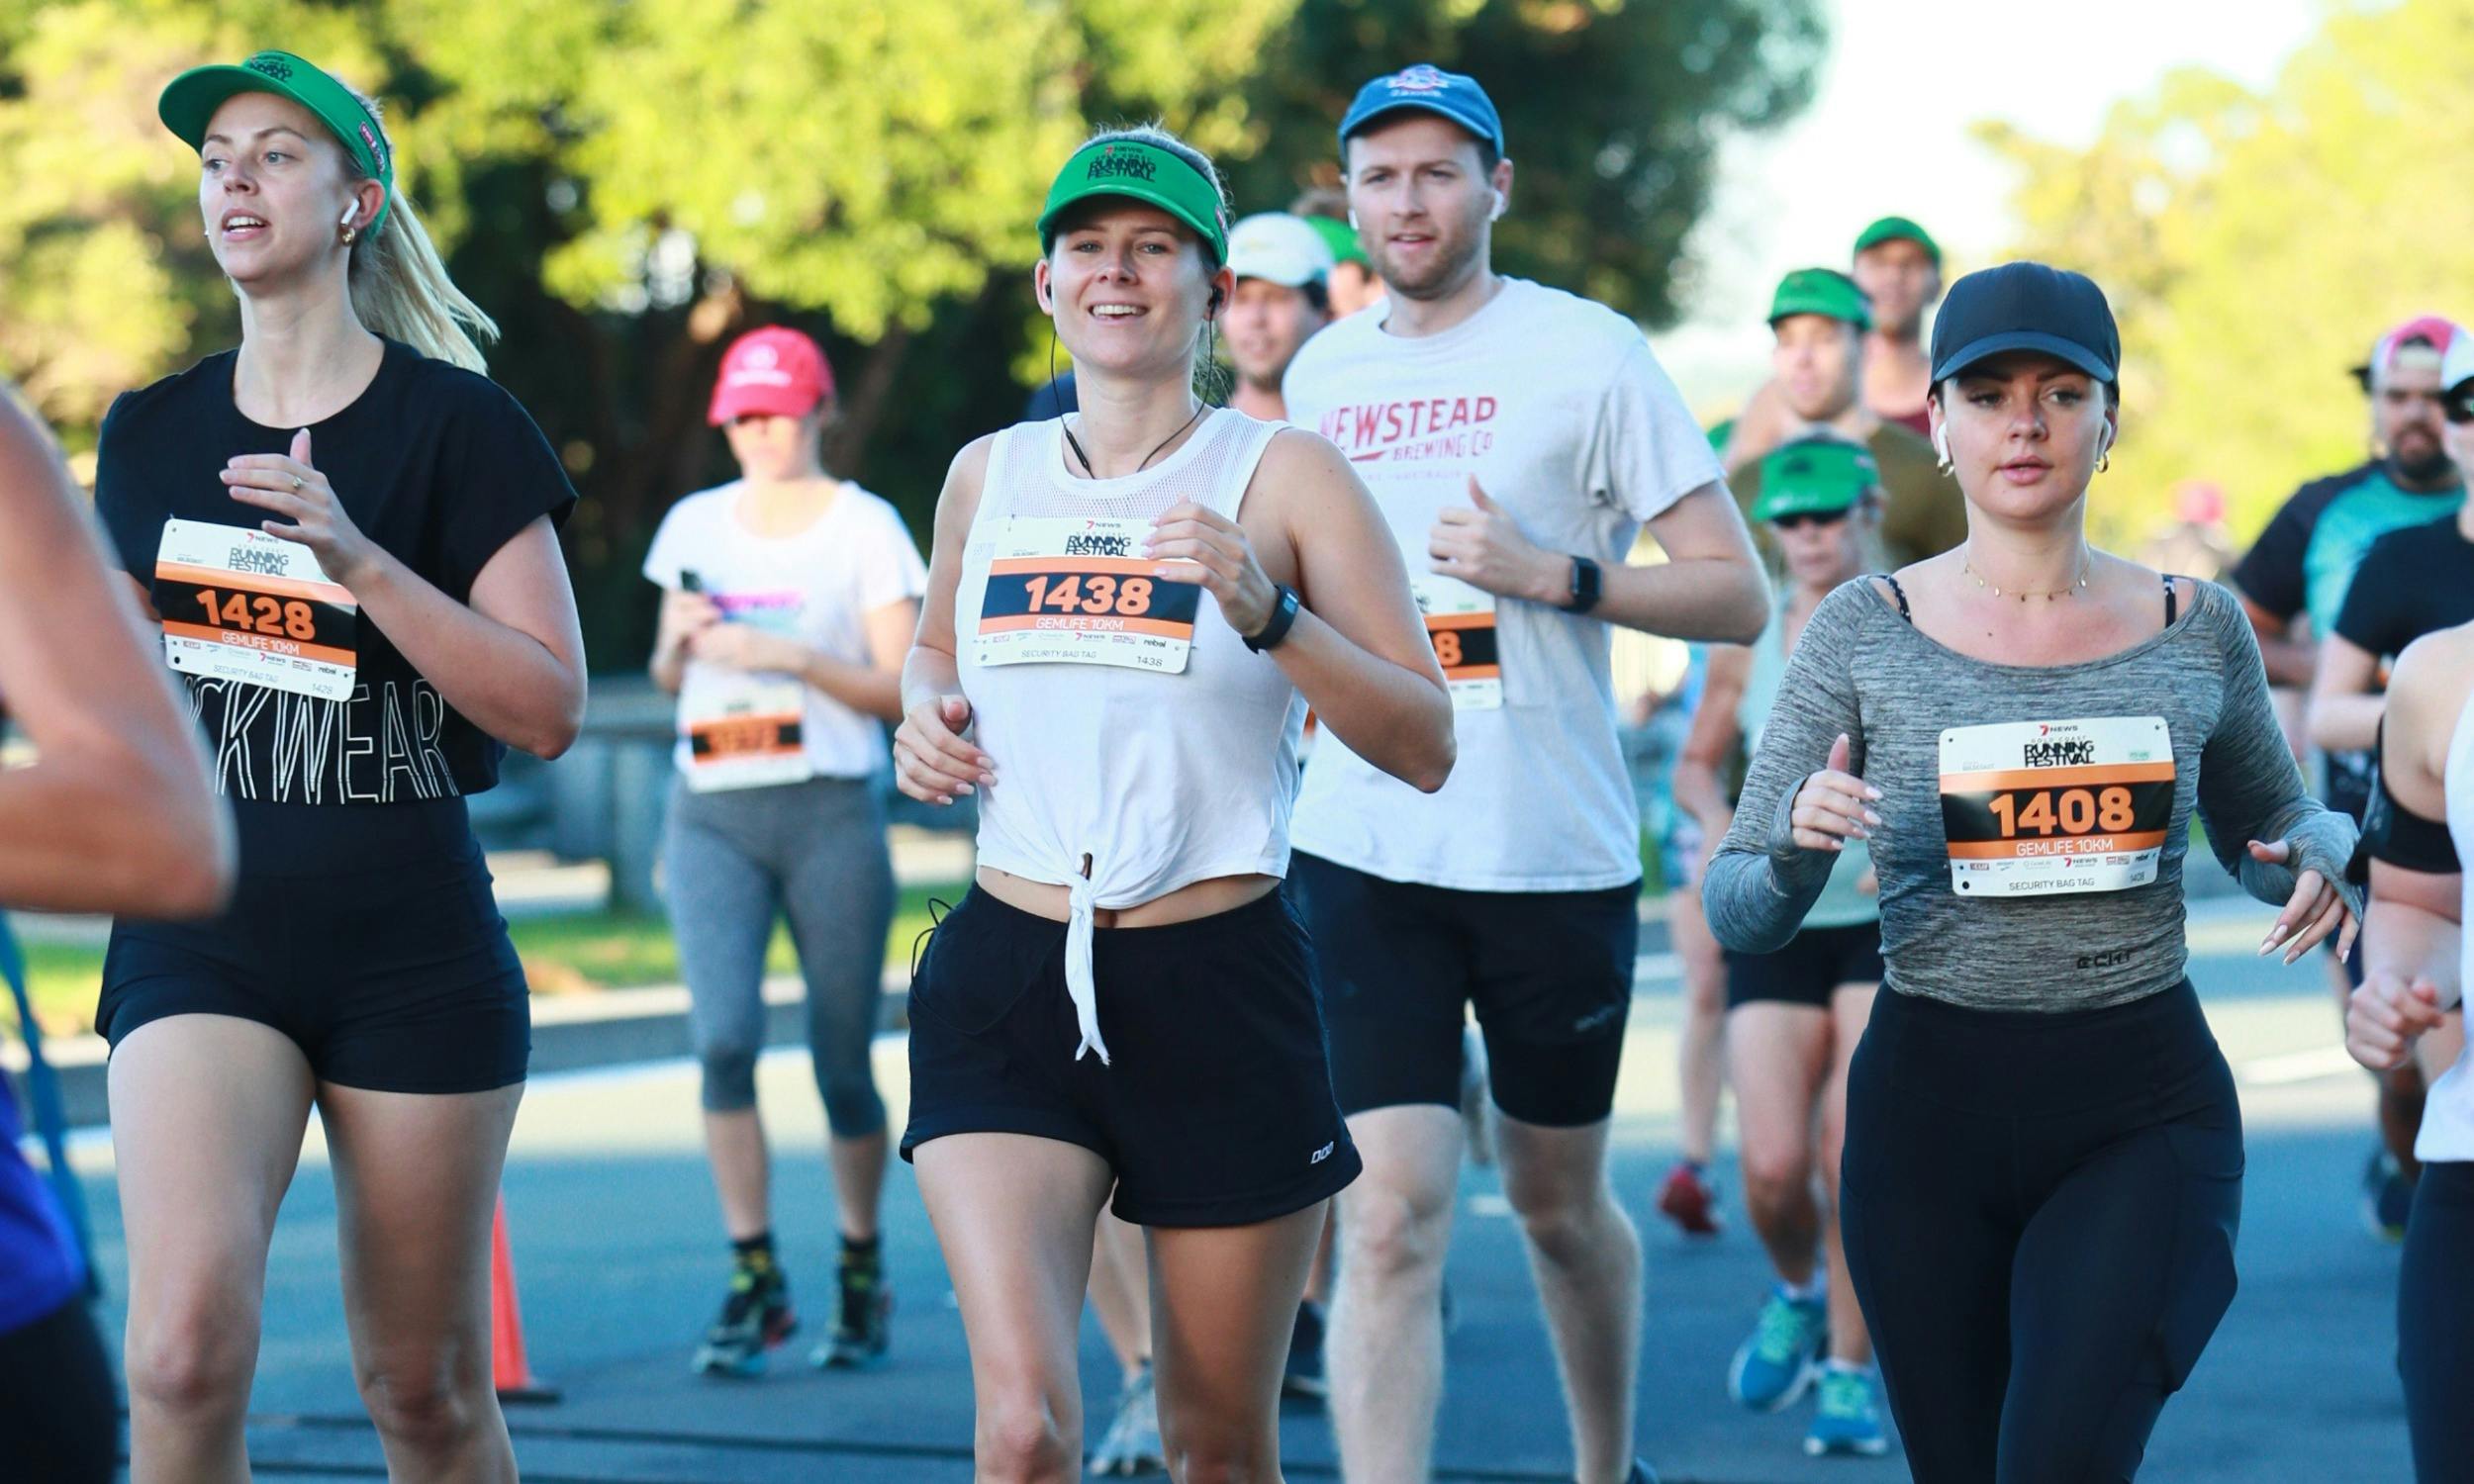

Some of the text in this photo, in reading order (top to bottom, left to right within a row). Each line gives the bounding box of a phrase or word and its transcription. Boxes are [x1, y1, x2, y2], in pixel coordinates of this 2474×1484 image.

[1067, 535, 1131, 548] RUNNING
[229, 547, 289, 566] RUNNING
[1065, 545, 1128, 557] FESTIVAL
[228, 558, 287, 577] FESTIVAL
[1025, 575, 1154, 616] 1438
[196, 590, 316, 640] 1428
[1035, 617, 1125, 631] GEMLIFE 10KM
[221, 631, 268, 650] GEMLIFE
[269, 640, 300, 655] 10KM
[1137, 656, 1164, 667] 1438
[2024, 740, 2094, 758] RUNNING
[2024, 751, 2095, 768] FESTIVAL
[1989, 787, 2135, 837] 1408
[2016, 839, 2114, 857] GEMLIFE 10KM
[2009, 878, 2095, 891] SECURITY BAG TAG
